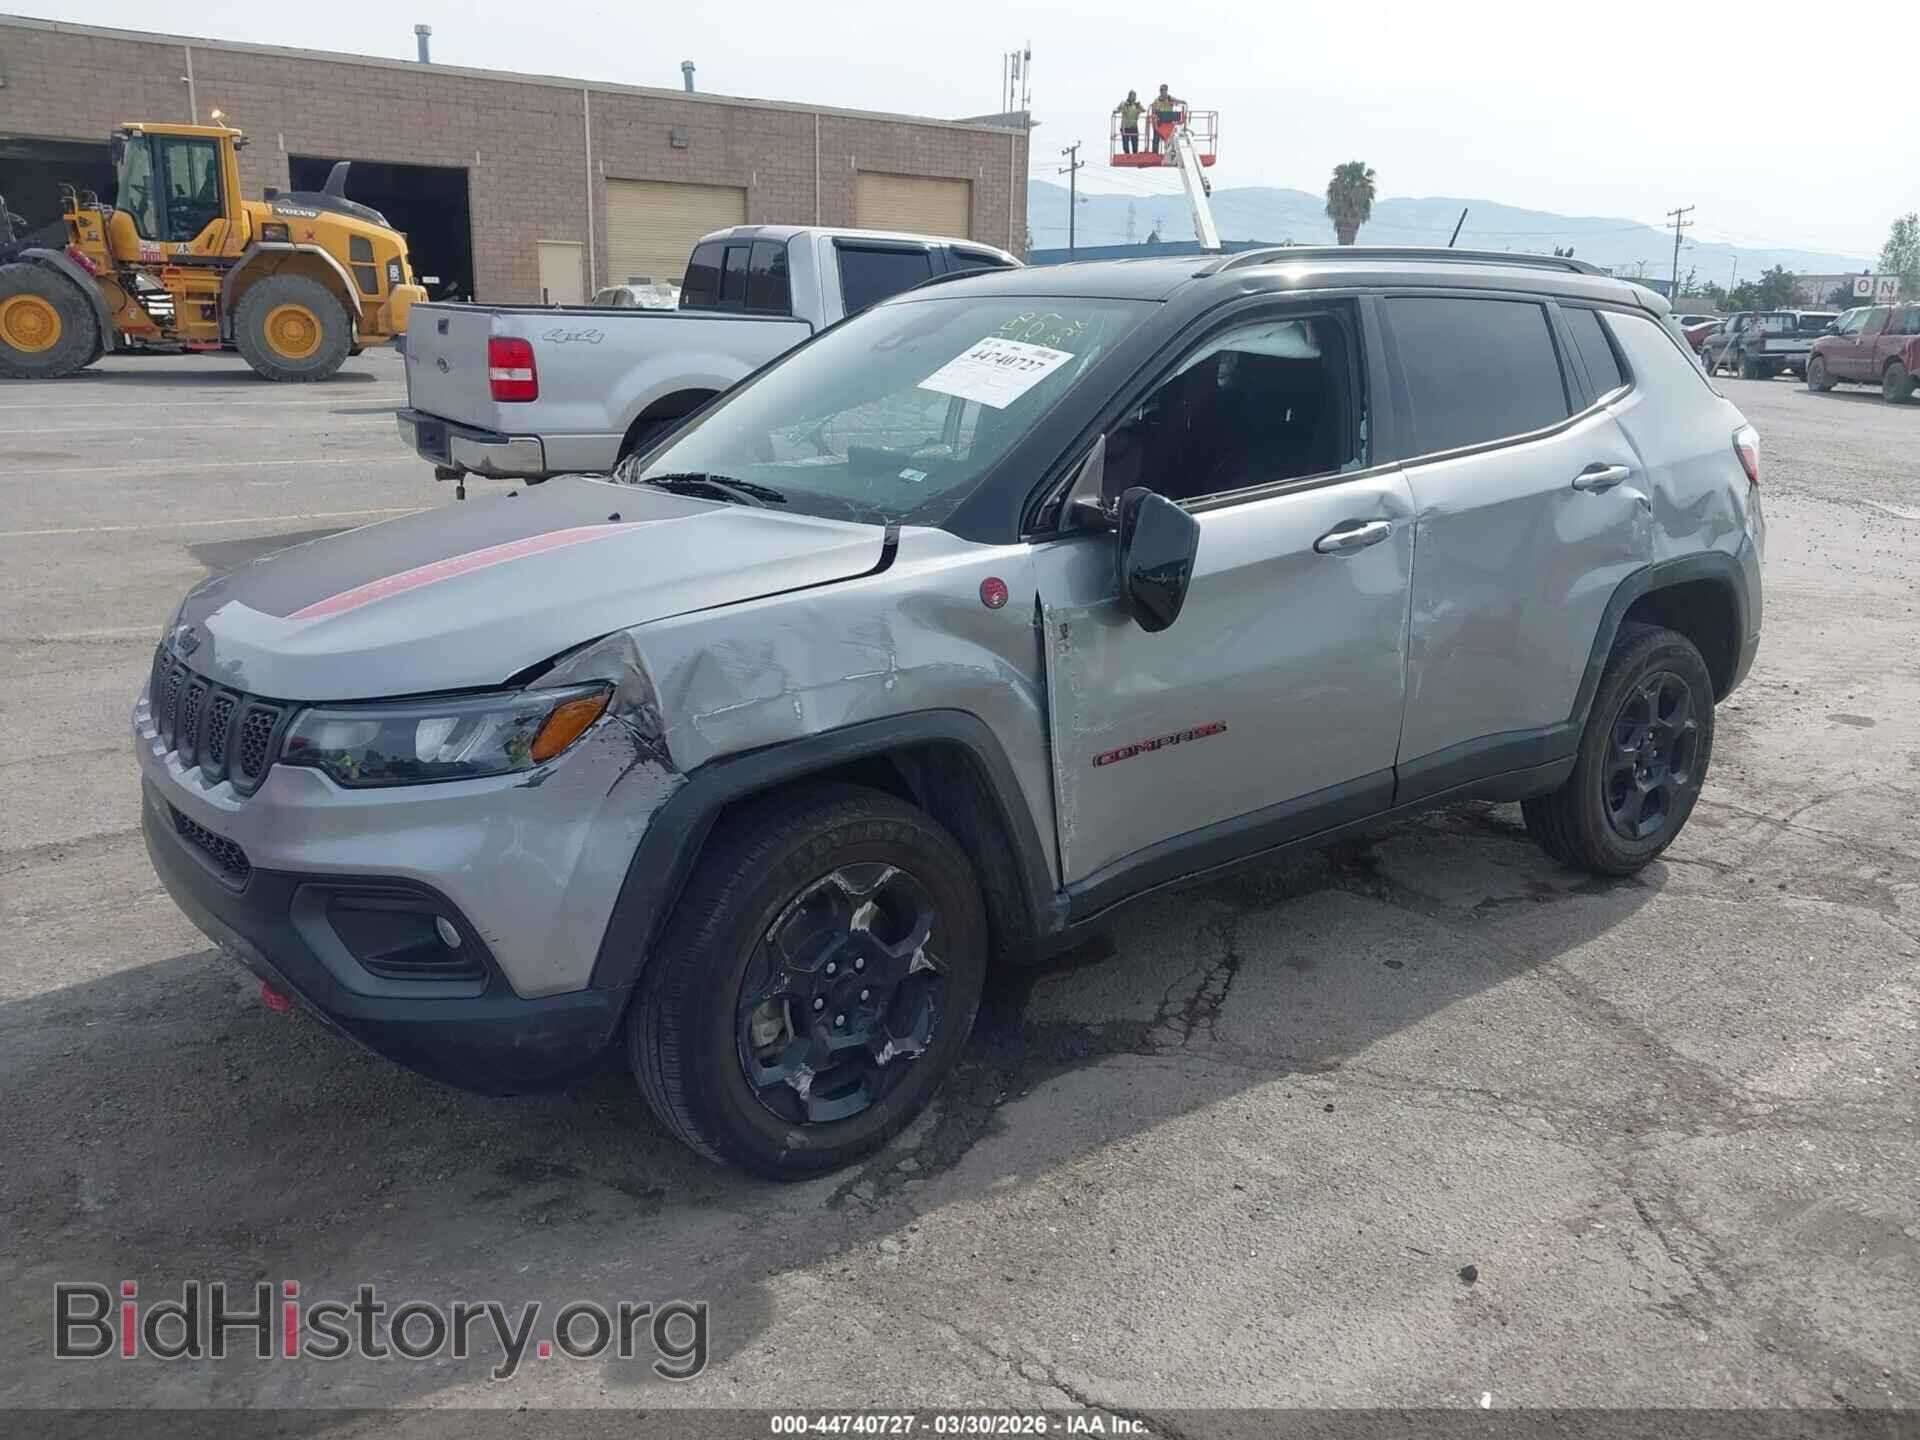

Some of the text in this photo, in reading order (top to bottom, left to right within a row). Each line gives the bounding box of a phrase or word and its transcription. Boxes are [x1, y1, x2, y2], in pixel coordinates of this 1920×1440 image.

[276, 207, 317, 217] VOLVO
[1858, 280, 1869, 293] O
[971, 350, 1046, 372] 44740727
